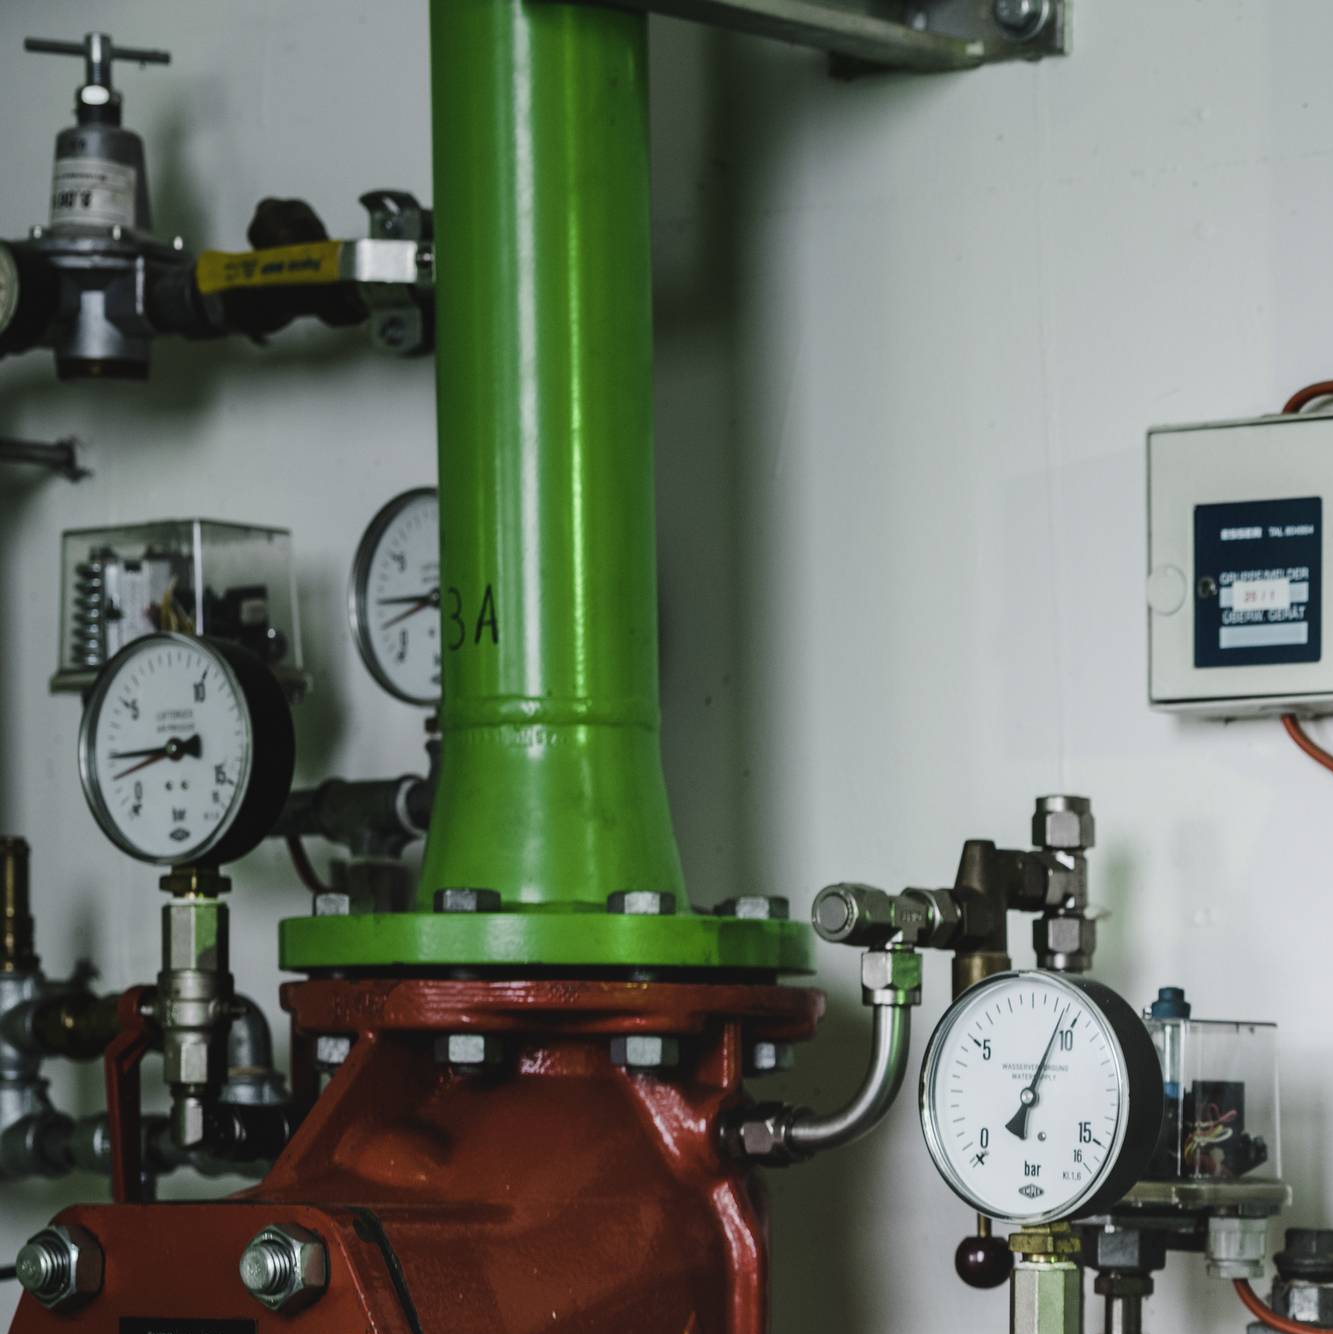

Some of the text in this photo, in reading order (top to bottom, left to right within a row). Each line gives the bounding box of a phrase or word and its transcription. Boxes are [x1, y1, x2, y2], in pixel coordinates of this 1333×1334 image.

[982, 1038, 992, 1061] 5
[1059, 1029, 1074, 1052] 10
[980, 1127, 990, 1150] 0
[1077, 1121, 1093, 1144] 15
[1073, 1149, 1083, 1164] 16
[1024, 1160, 1041, 1177] bar
